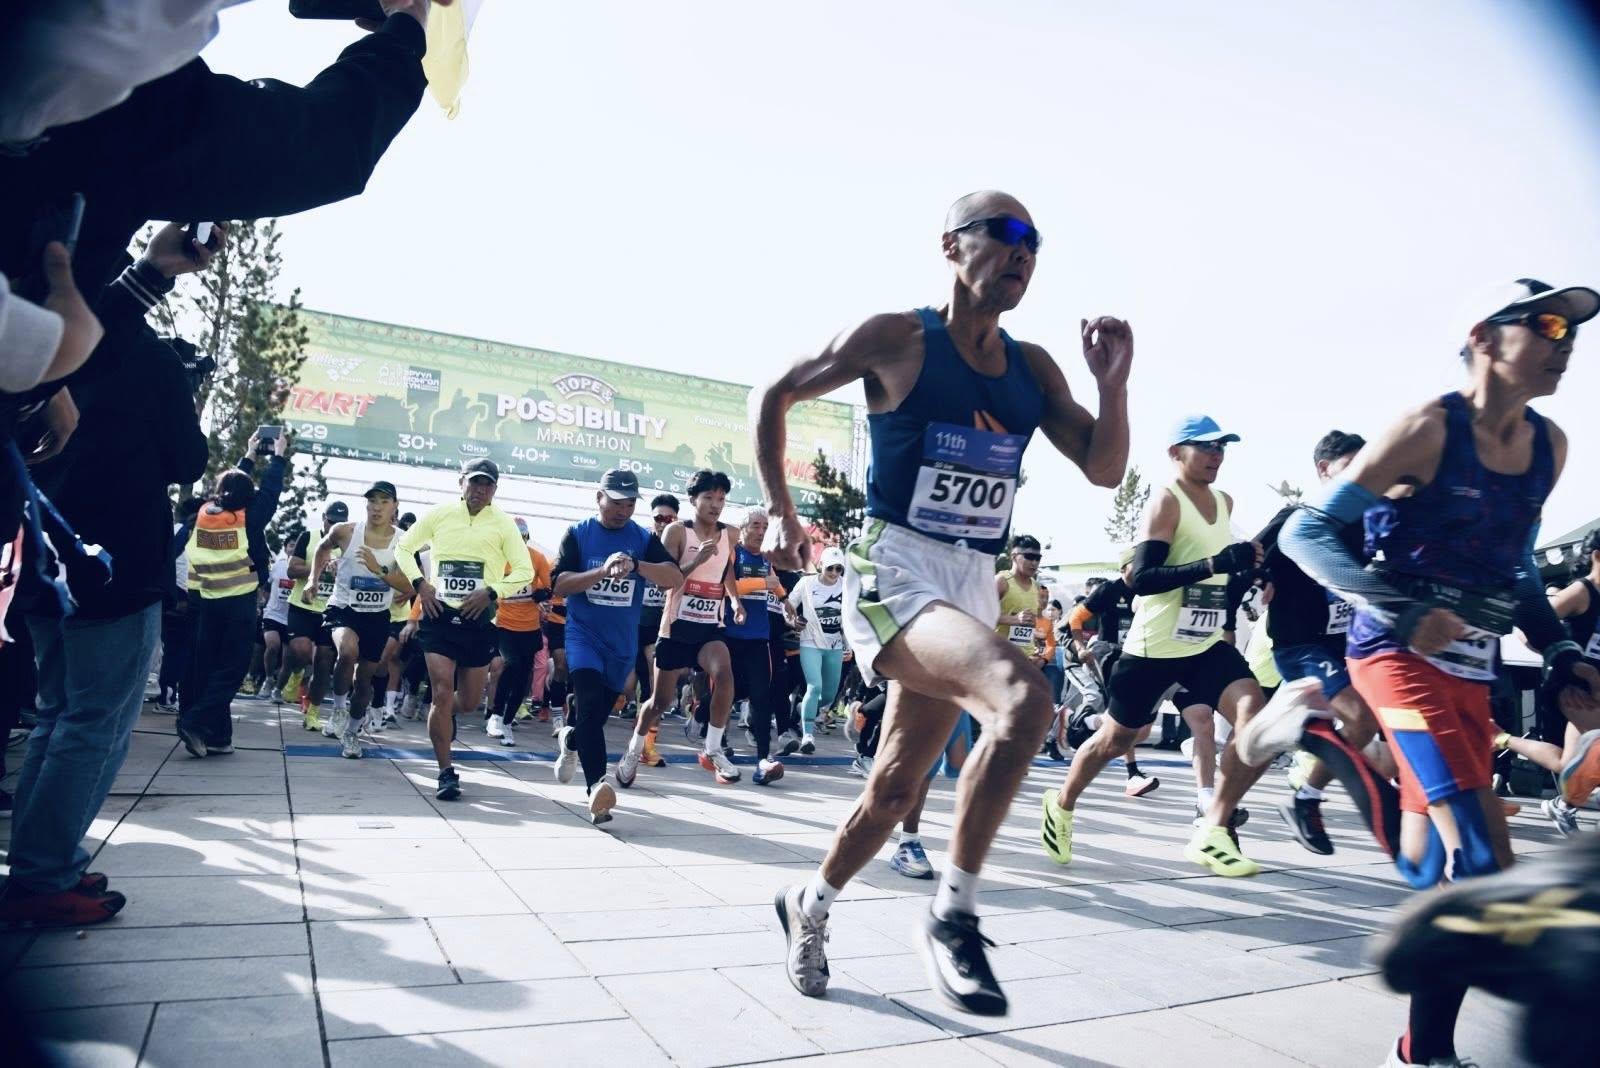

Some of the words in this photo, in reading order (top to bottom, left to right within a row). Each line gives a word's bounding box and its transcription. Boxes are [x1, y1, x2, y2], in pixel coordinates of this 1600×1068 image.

[555, 376, 600, 395] HOPE
[601, 388, 613, 402] &
[288, 386, 376, 418] TART
[496, 393, 667, 439] POSSIBILITY
[536, 427, 631, 452] MARATHON
[936, 431, 967, 450] 11th
[398, 433, 437, 450] 30+
[511, 446, 550, 462] 40+
[619, 458, 653, 474] 50+
[799, 489, 825, 505] 70+
[929, 473, 1006, 509] 5700
[443, 578, 476, 591] 1099
[356, 592, 384, 602] 0201
[687, 598, 716, 612] 4032
[1191, 610, 1219, 628] 7711
[1014, 627, 1032, 637] 0527
[1318, 661, 1339, 678] 2
